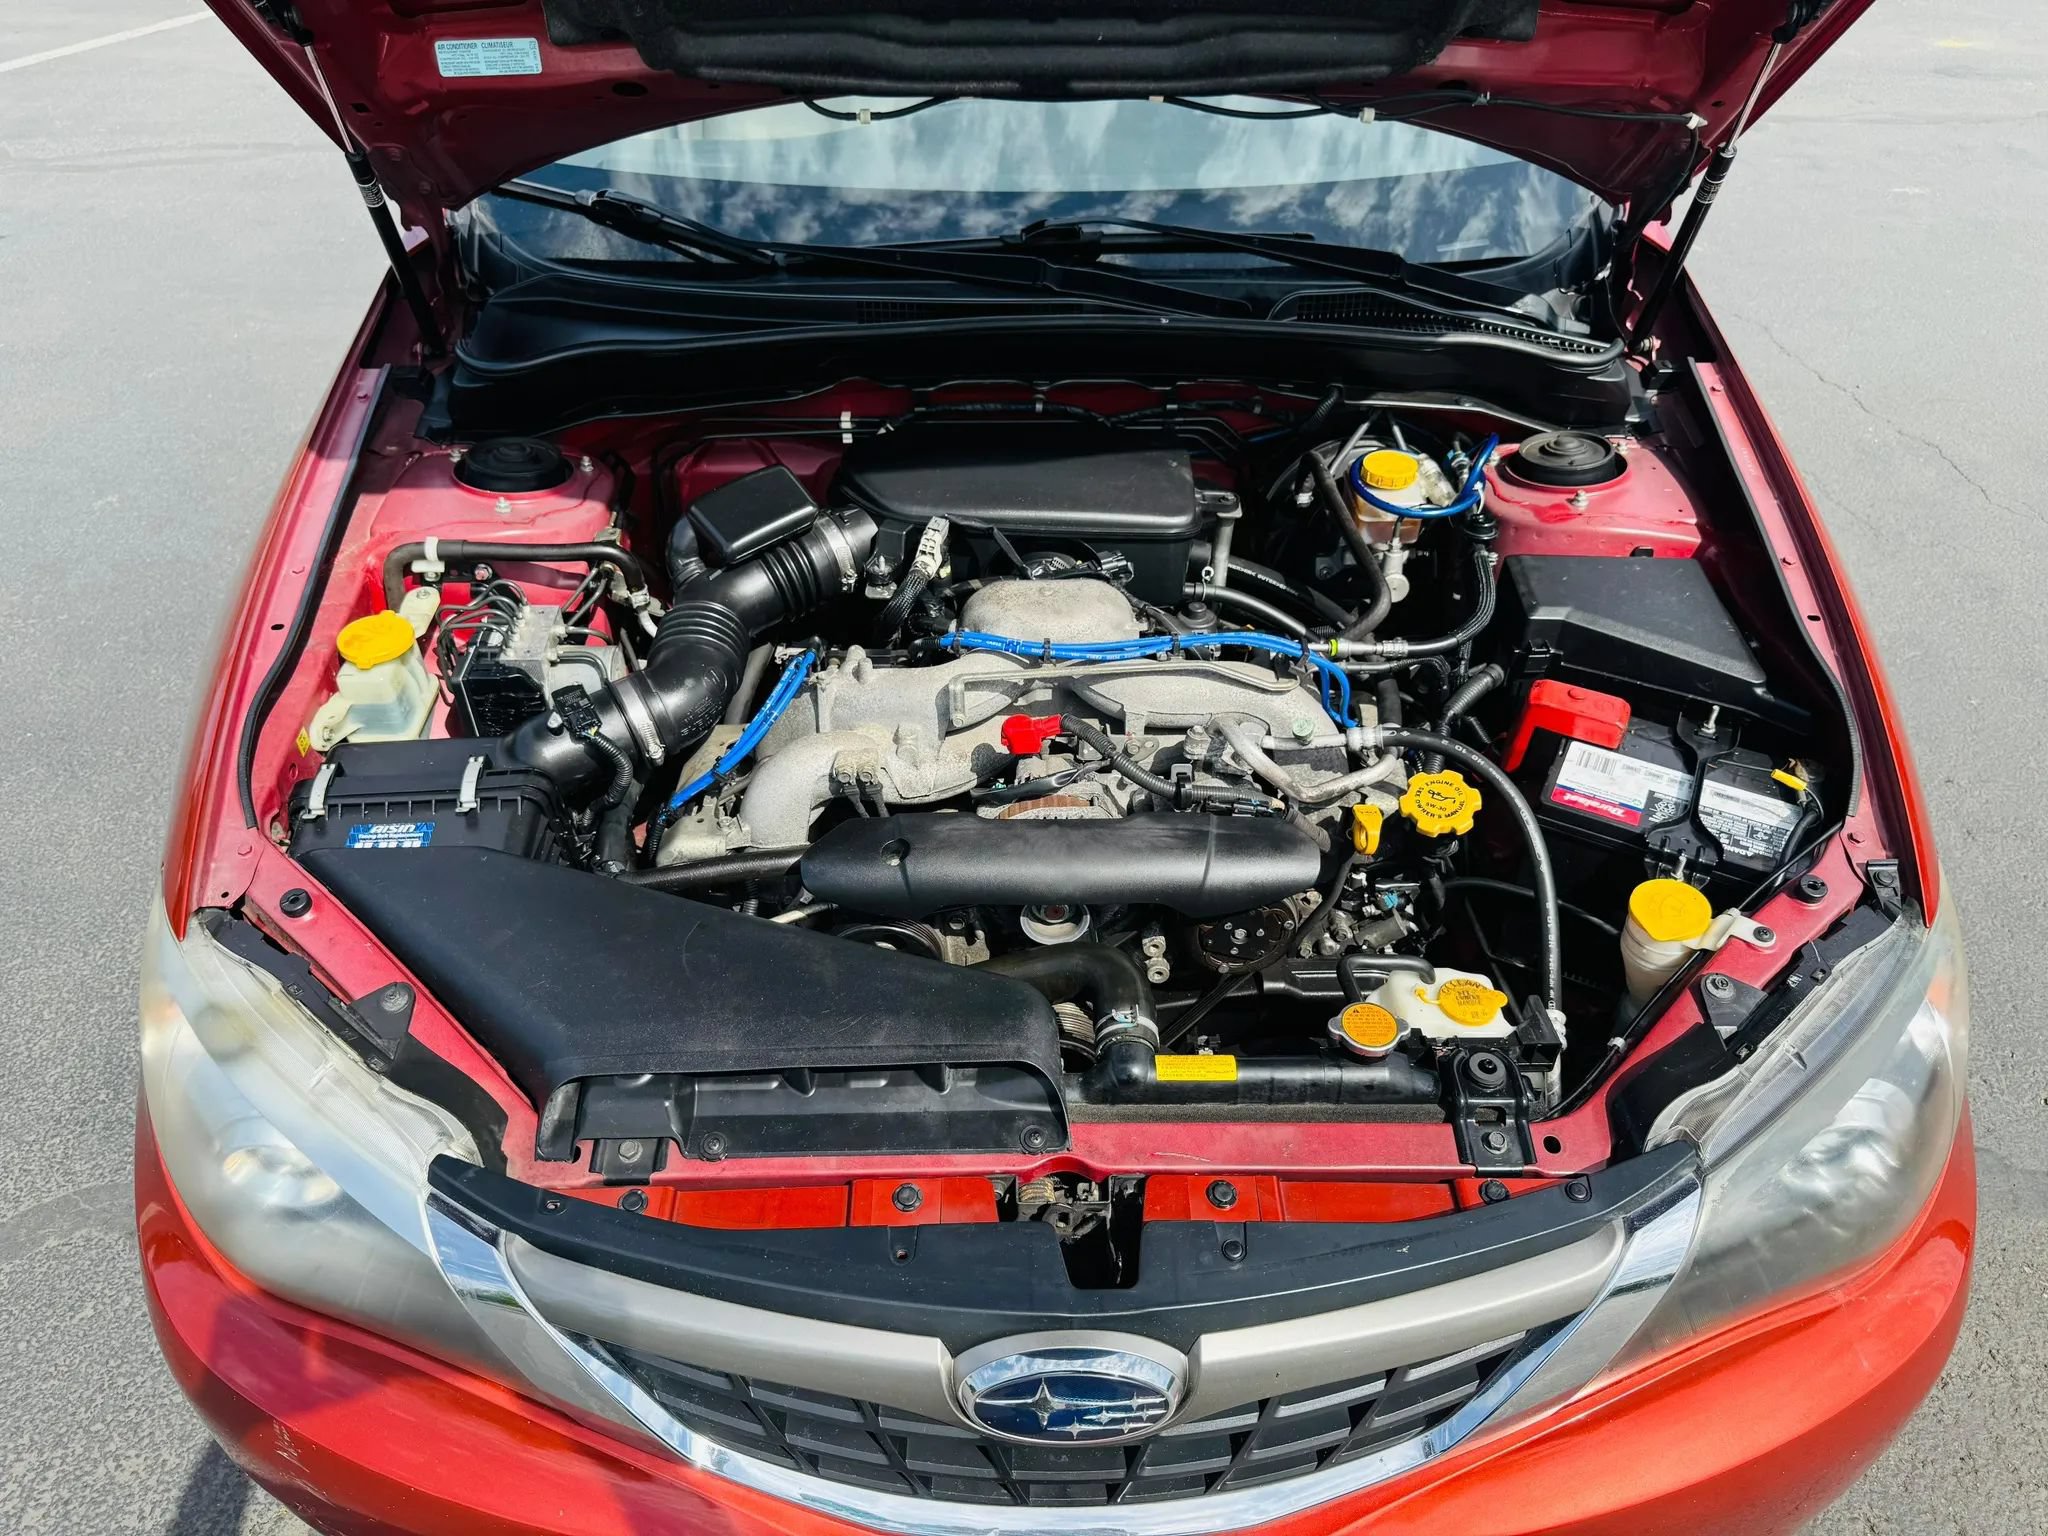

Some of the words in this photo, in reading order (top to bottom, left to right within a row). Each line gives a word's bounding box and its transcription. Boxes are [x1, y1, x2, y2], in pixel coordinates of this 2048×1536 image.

[446, 42, 477, 50] CONDITIONER
[481, 41, 513, 49] CLIMATISEUR
[1415, 787, 1424, 797] SEE
[1455, 787, 1463, 796] OIL
[1415, 799, 1442, 819] OWNER'S
[1445, 800, 1465, 818] MANUAL
[1563, 792, 1625, 817] Duralast
